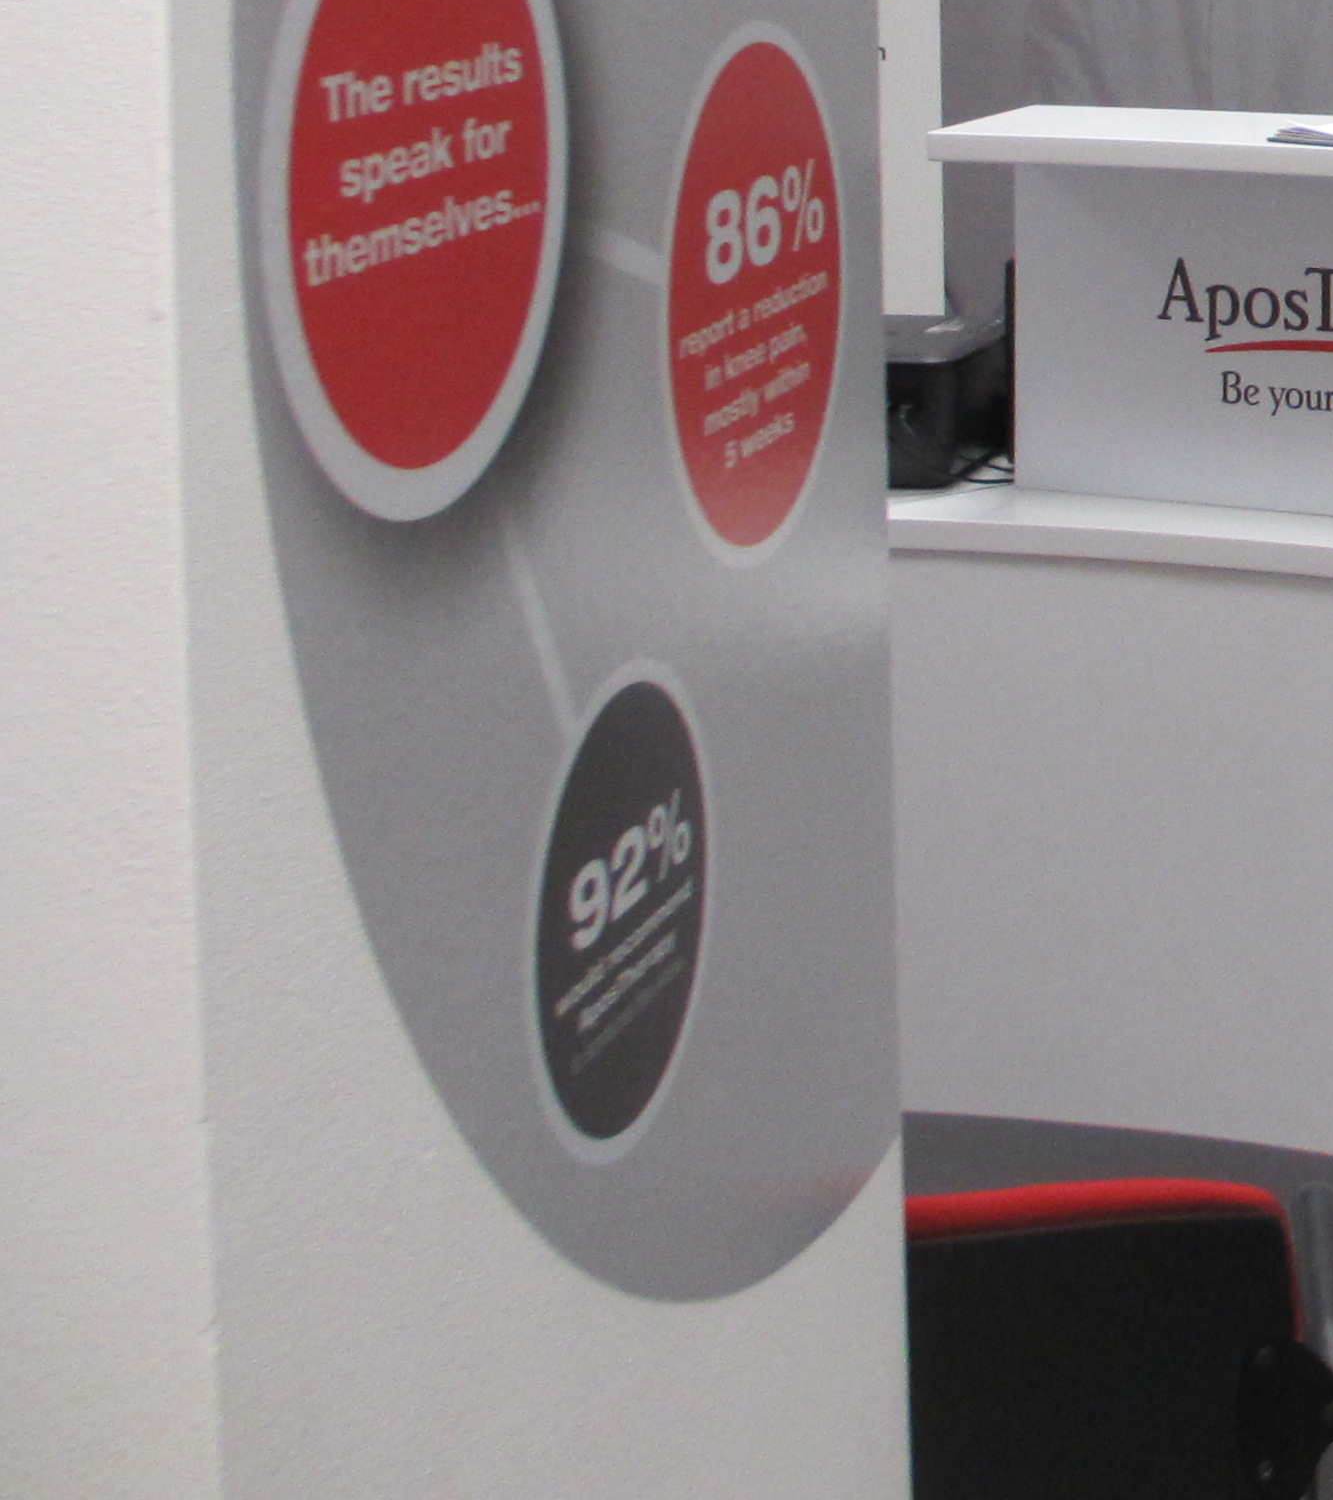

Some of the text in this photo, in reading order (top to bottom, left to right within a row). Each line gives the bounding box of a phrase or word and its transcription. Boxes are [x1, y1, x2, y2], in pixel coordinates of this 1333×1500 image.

[321, 42, 522, 121] The results
[341, 118, 512, 203] speak for
[304, 189, 543, 288] themselves...
[708, 159, 825, 284] 86%
[679, 311, 735, 359] report
[738, 308, 750, 330] a
[1222, 371, 1259, 405] Be
[741, 412, 795, 458] weeks
[570, 789, 691, 951] 92%
